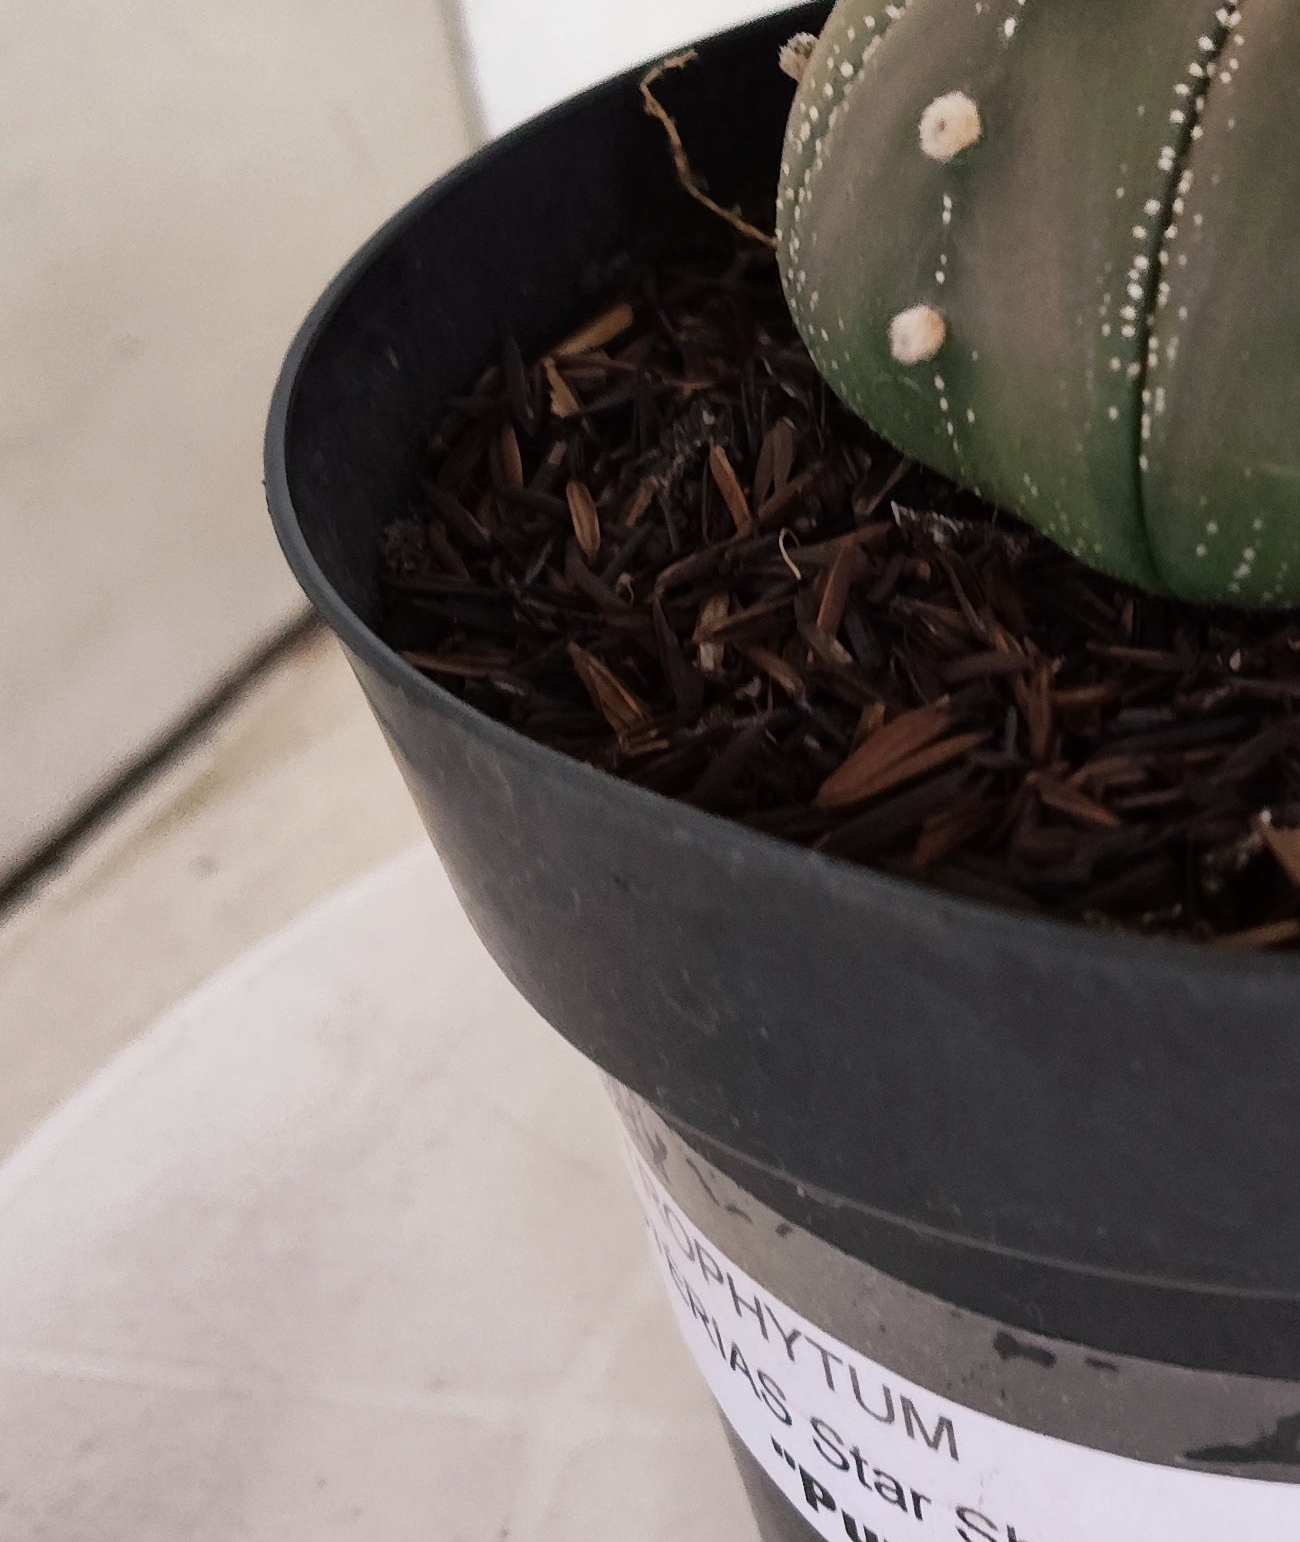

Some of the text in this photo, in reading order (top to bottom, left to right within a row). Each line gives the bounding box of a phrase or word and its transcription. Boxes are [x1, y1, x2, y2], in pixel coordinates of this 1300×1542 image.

[640, 1161, 961, 1460] OPHYTUM
[647, 1216, 793, 1426] ERIAS
[811, 1417, 932, 1521] Star
